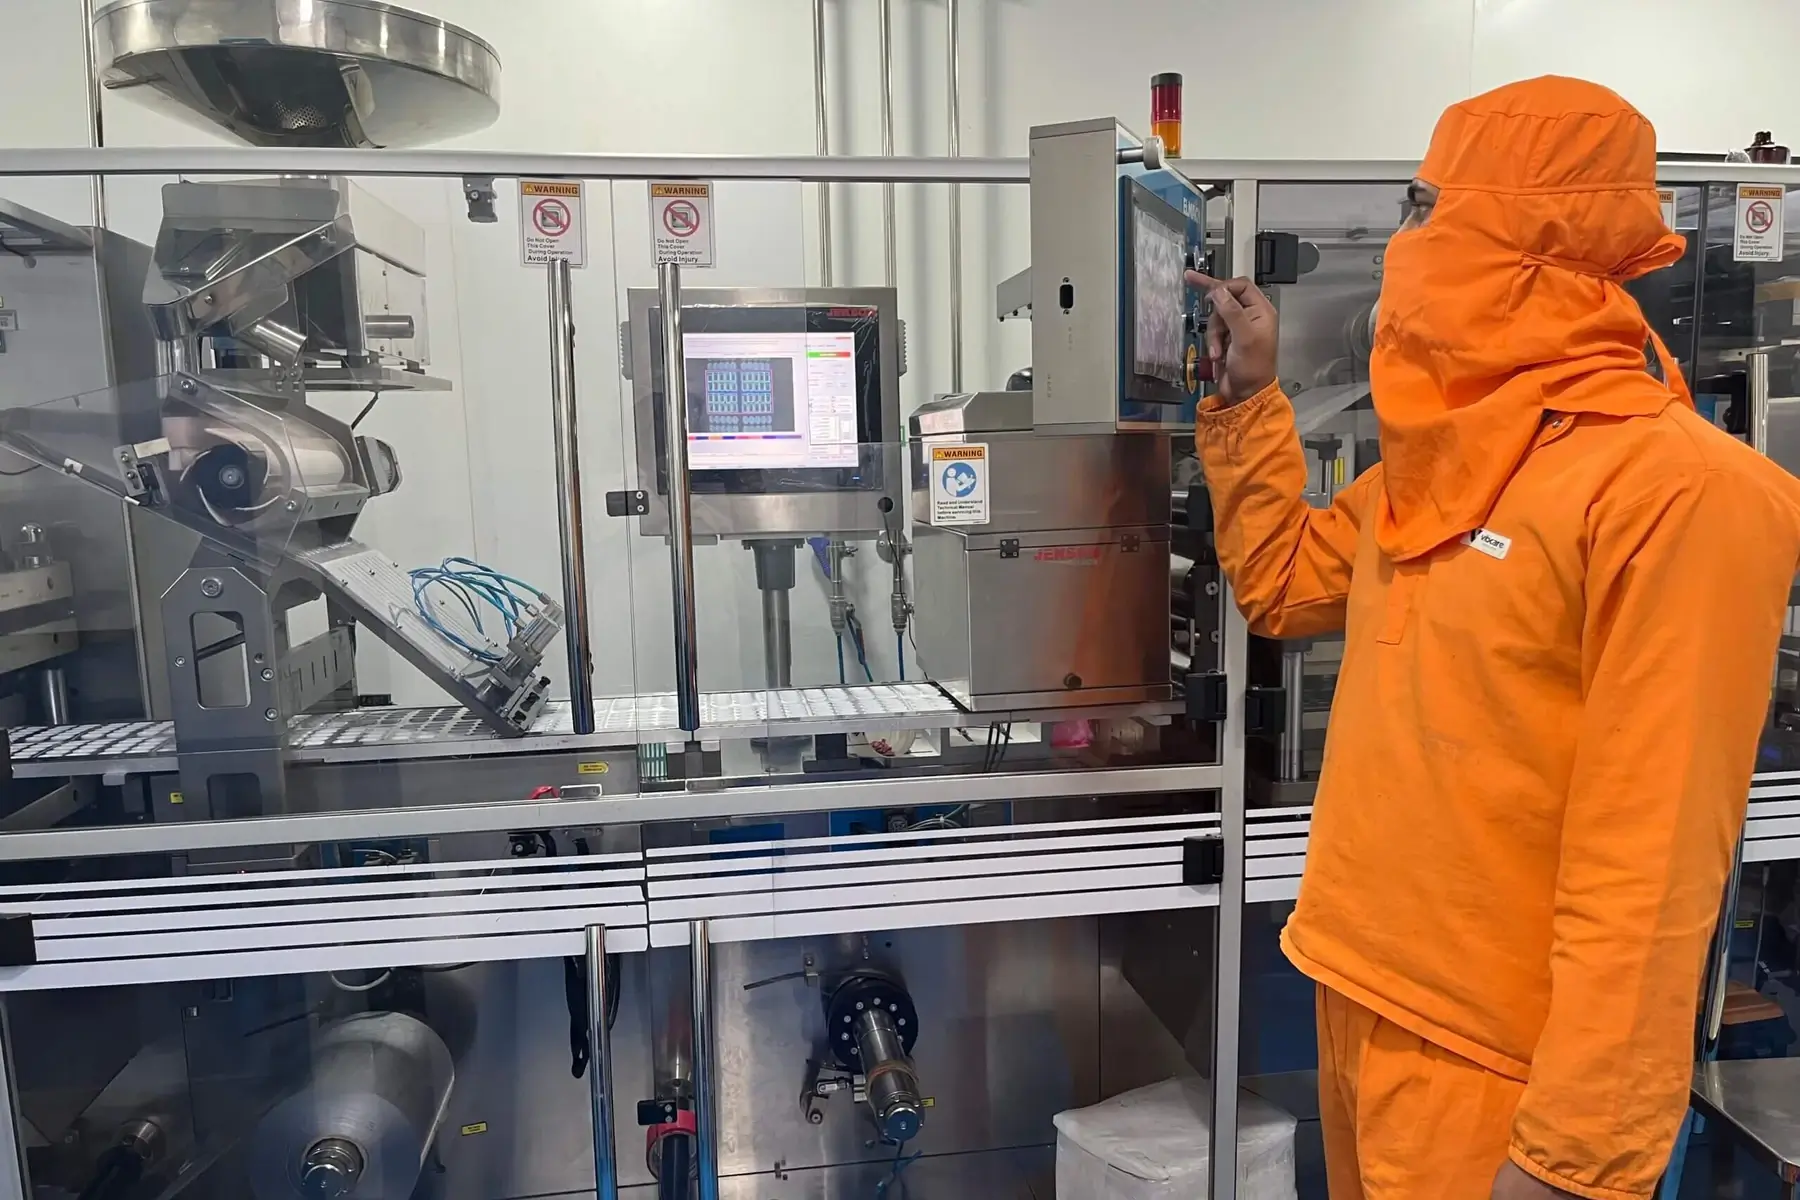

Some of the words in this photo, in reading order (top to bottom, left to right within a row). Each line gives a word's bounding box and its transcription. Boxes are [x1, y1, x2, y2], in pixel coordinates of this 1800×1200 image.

[533, 185, 578, 194] WARNING
[664, 187, 706, 195] WARNING
[944, 450, 982, 458] WARNING
